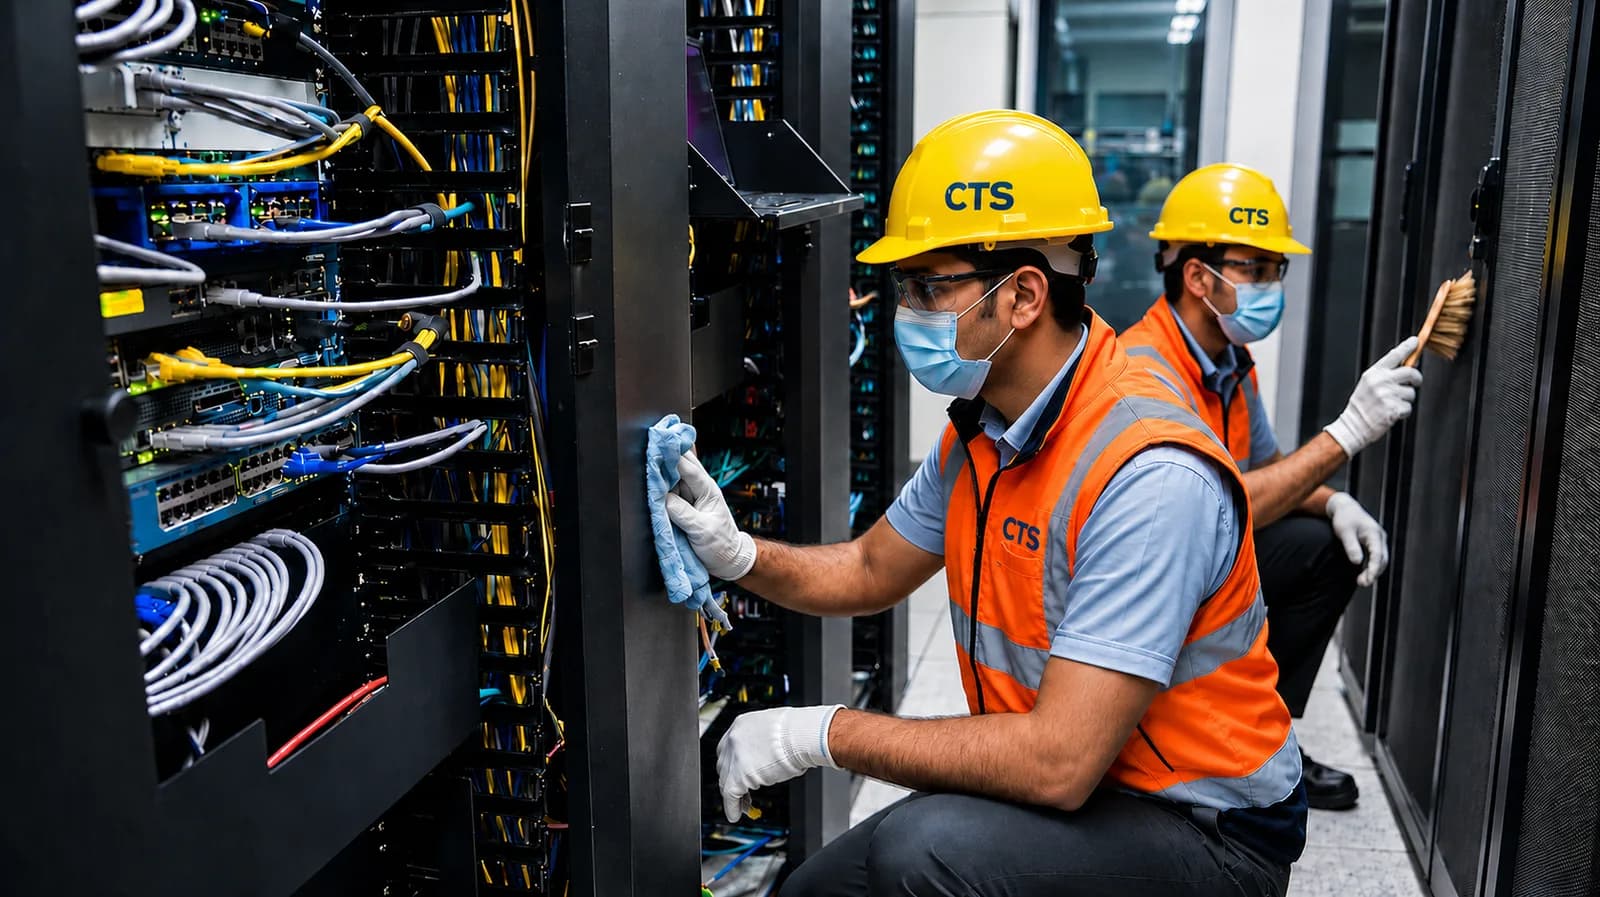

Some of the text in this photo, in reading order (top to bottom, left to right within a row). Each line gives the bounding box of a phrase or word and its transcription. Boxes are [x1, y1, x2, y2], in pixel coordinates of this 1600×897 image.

[945, 181, 1014, 211] CTS
[1229, 206, 1269, 226] CTS
[1002, 516, 1040, 551] CTS
